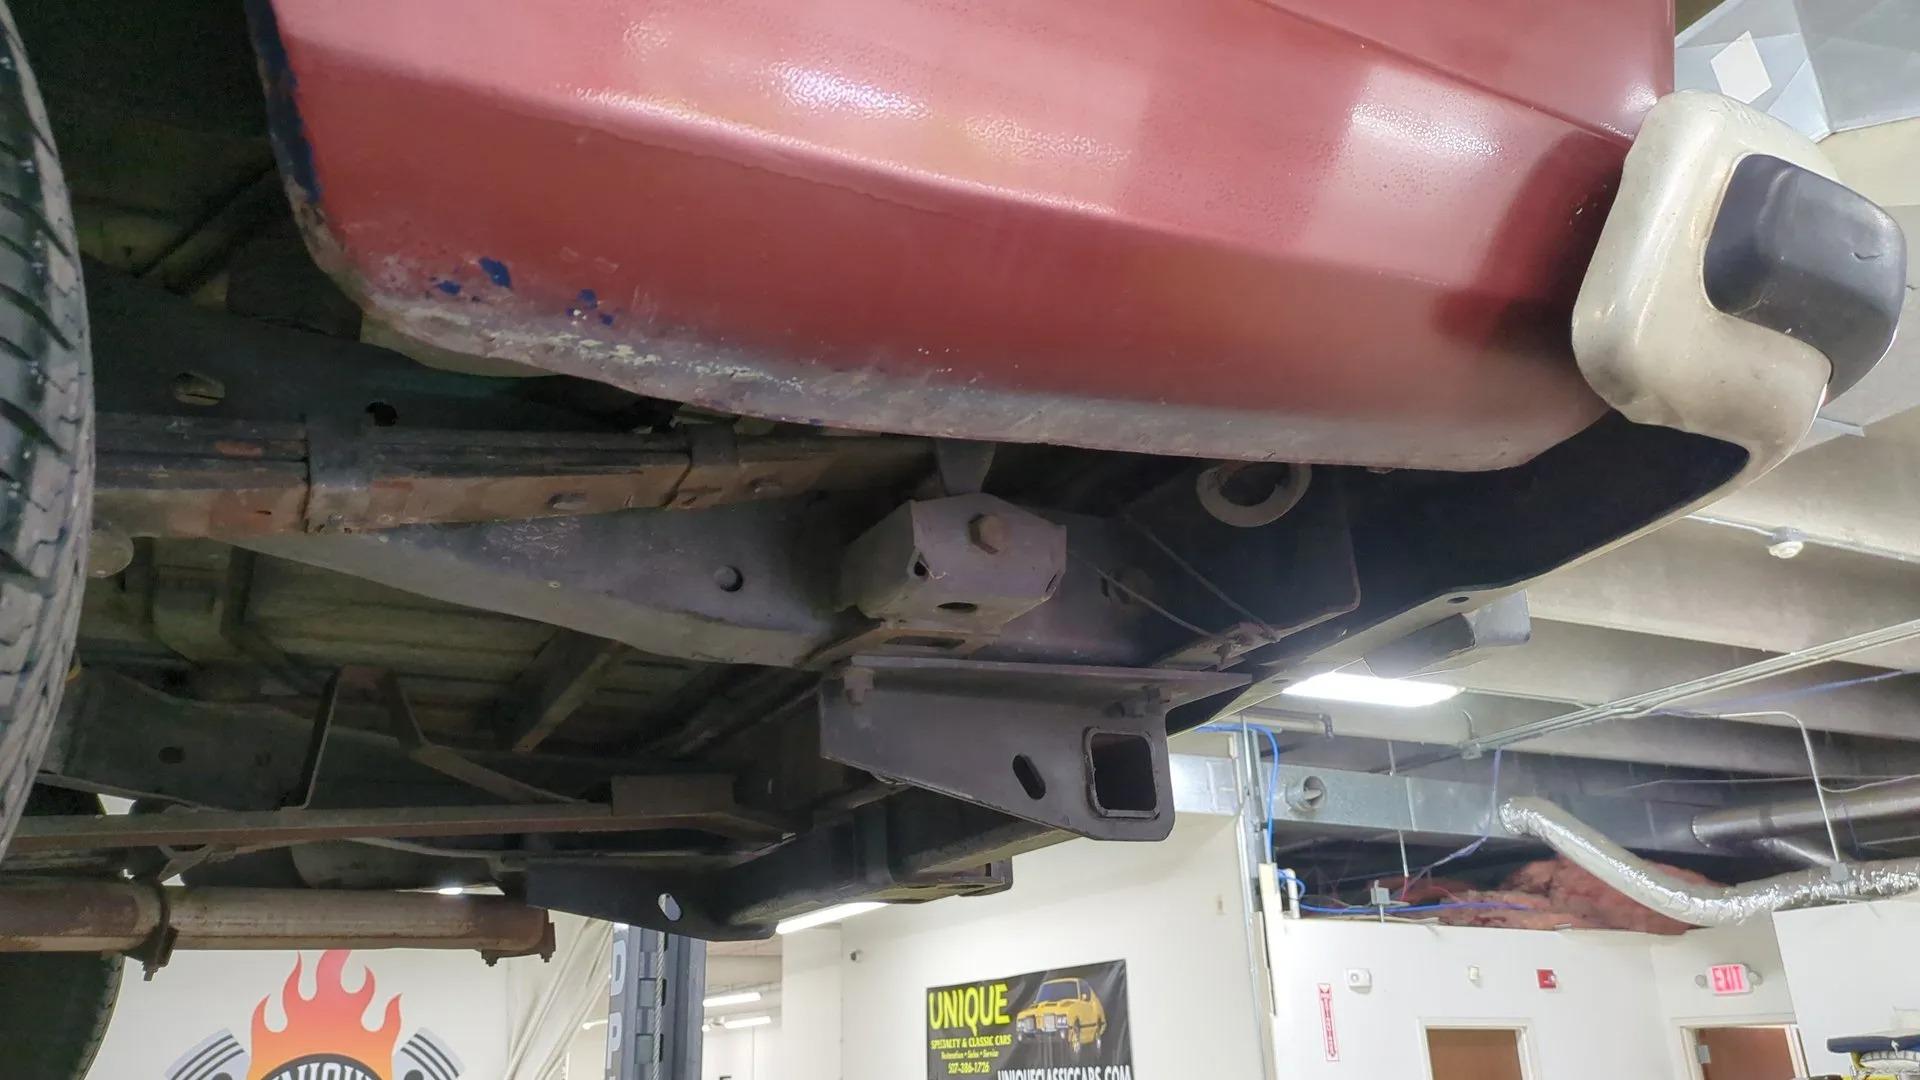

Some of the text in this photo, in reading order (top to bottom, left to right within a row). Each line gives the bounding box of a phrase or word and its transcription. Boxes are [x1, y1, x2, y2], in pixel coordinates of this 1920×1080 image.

[1712, 966, 1743, 992] EXIT
[929, 983, 1011, 1036] UNIQUE
[930, 1034, 1012, 1049] SPECIALTY & CLASSIC CARS
[997, 1065, 1132, 1080] UNIQUECLASSICCARSCOM
